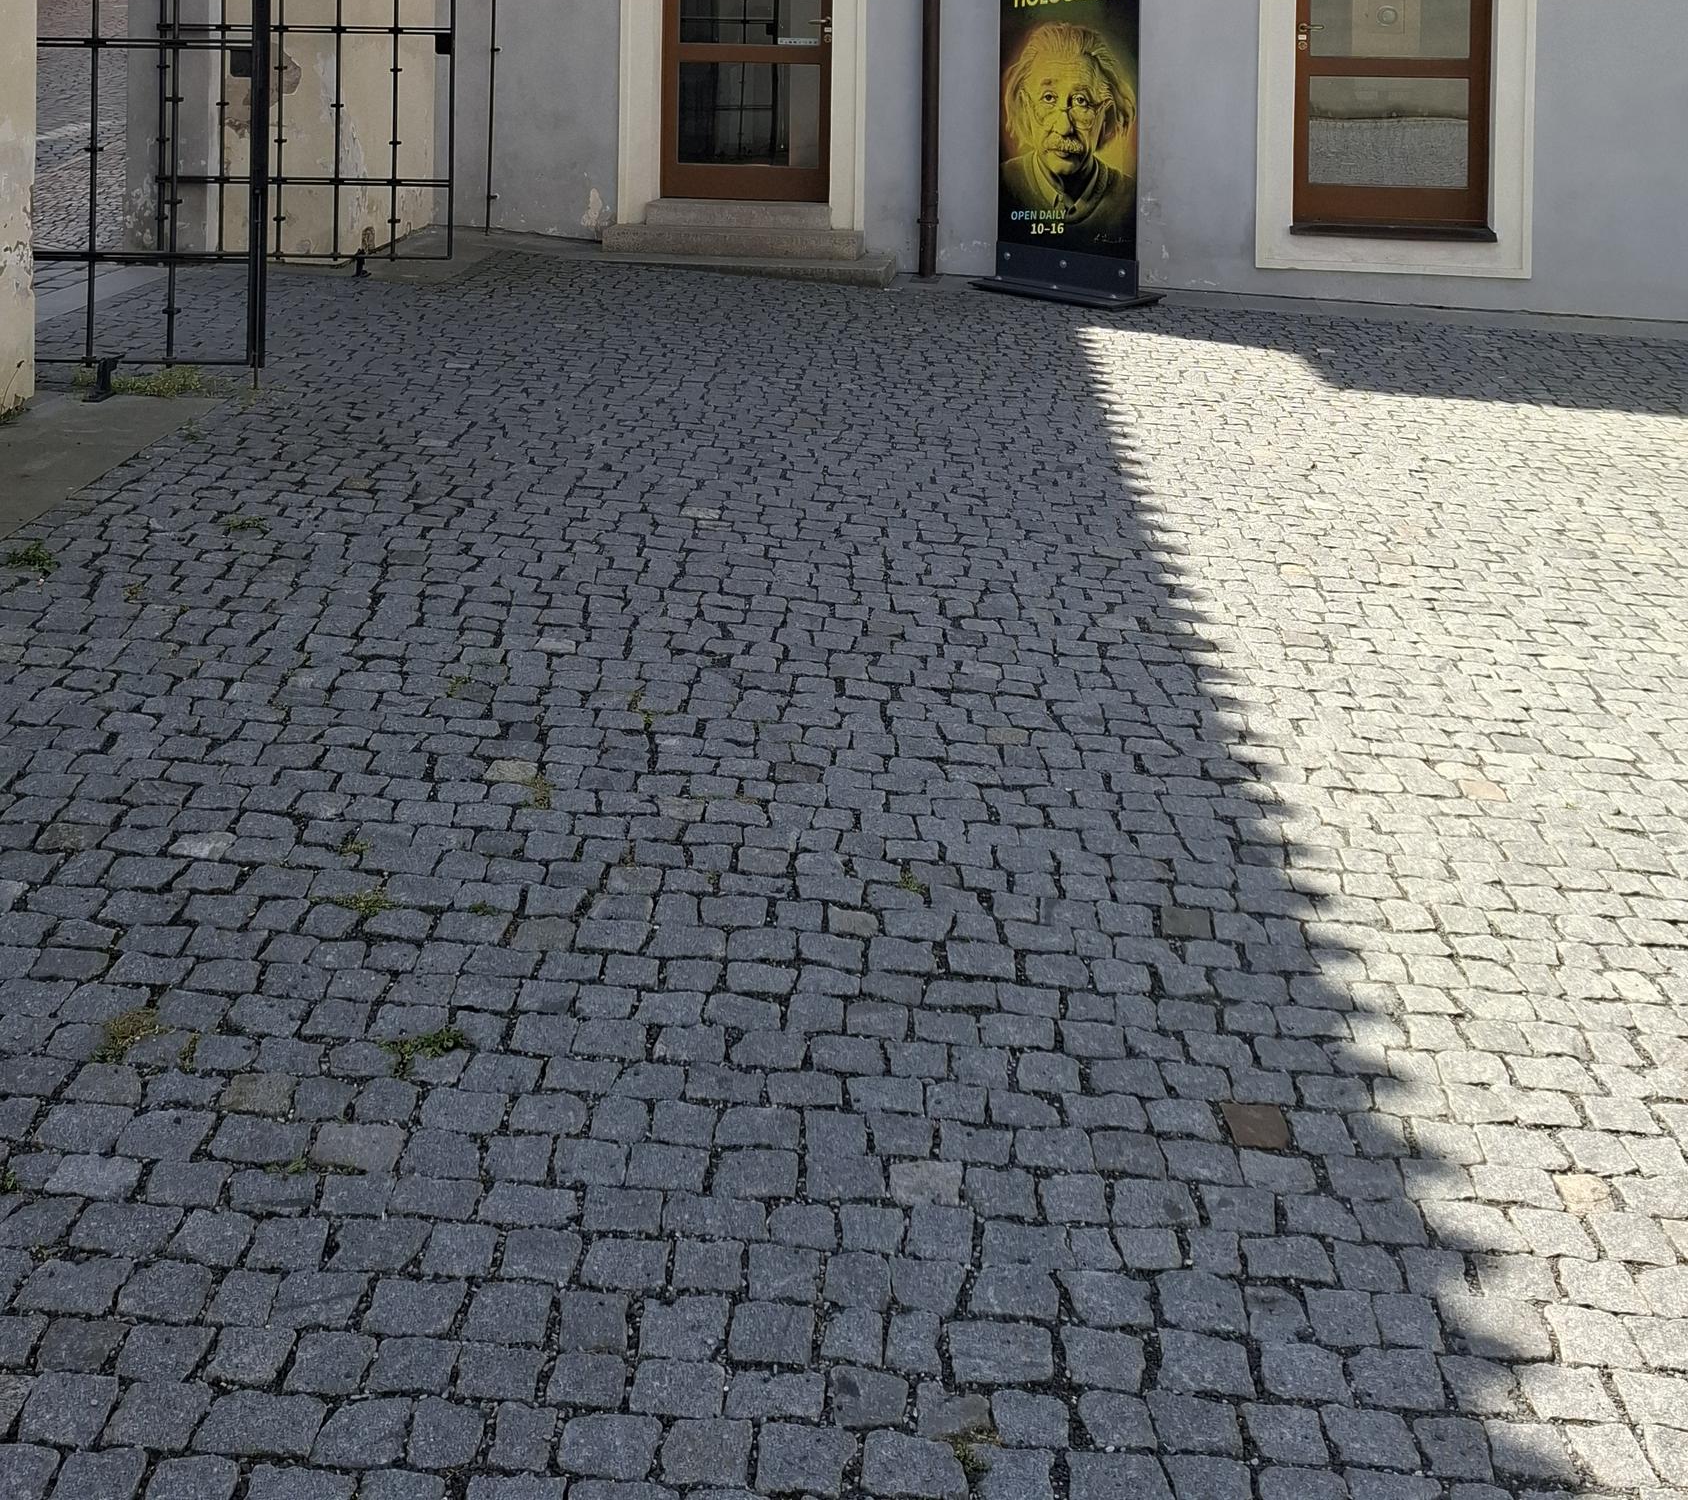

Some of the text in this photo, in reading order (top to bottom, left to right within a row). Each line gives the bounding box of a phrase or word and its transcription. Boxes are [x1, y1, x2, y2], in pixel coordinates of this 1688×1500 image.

[1011, 209, 1066, 221] OPEN DAILY
[1030, 222, 1064, 235] 10-16
